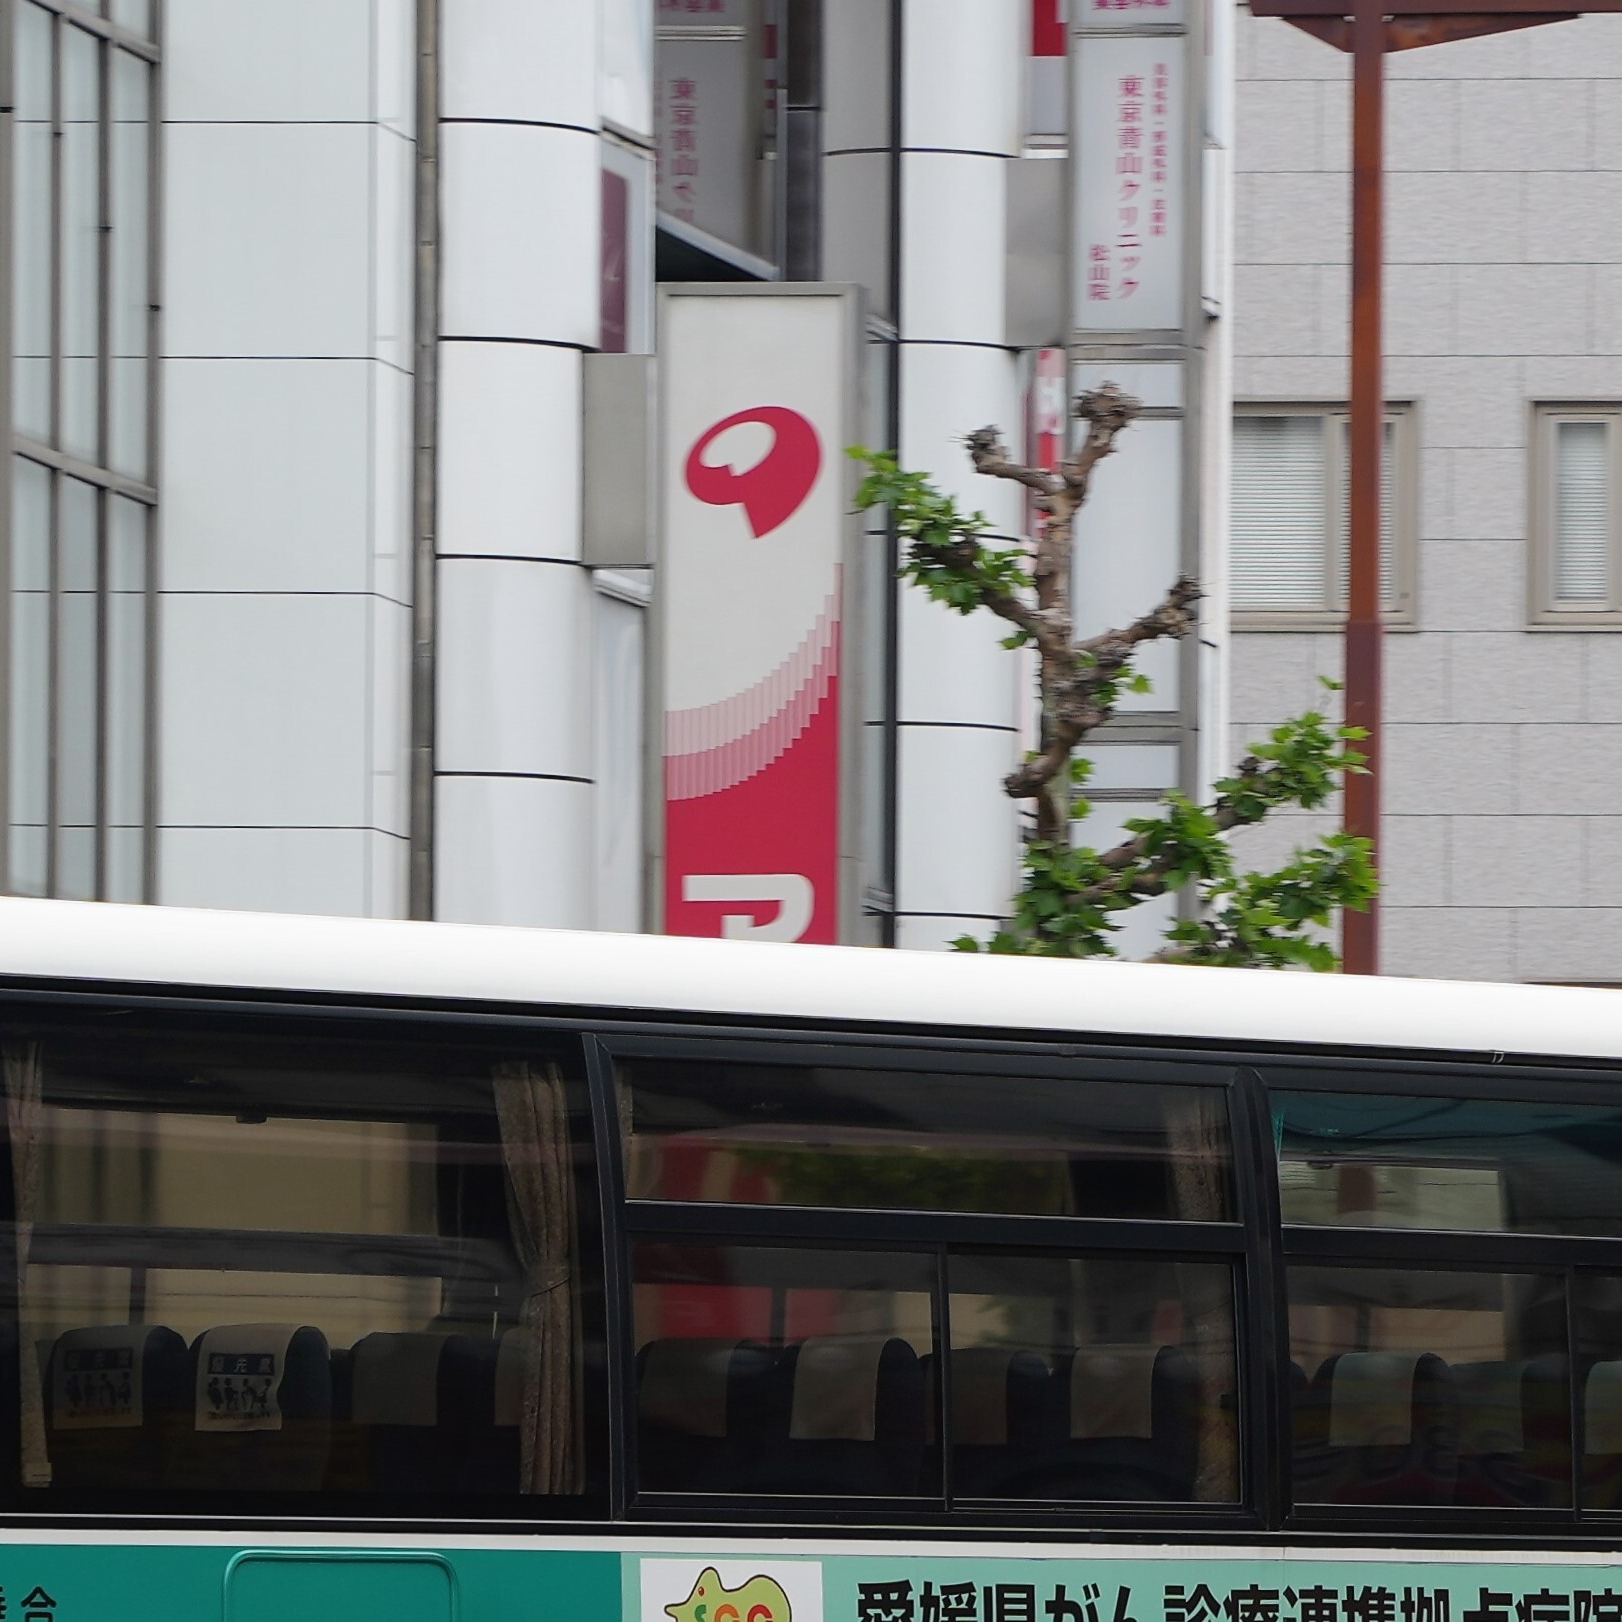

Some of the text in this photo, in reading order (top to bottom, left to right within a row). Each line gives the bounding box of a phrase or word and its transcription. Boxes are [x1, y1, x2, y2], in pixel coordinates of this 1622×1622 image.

[1116, 74, 1145, 300] 東京青山クリニック
